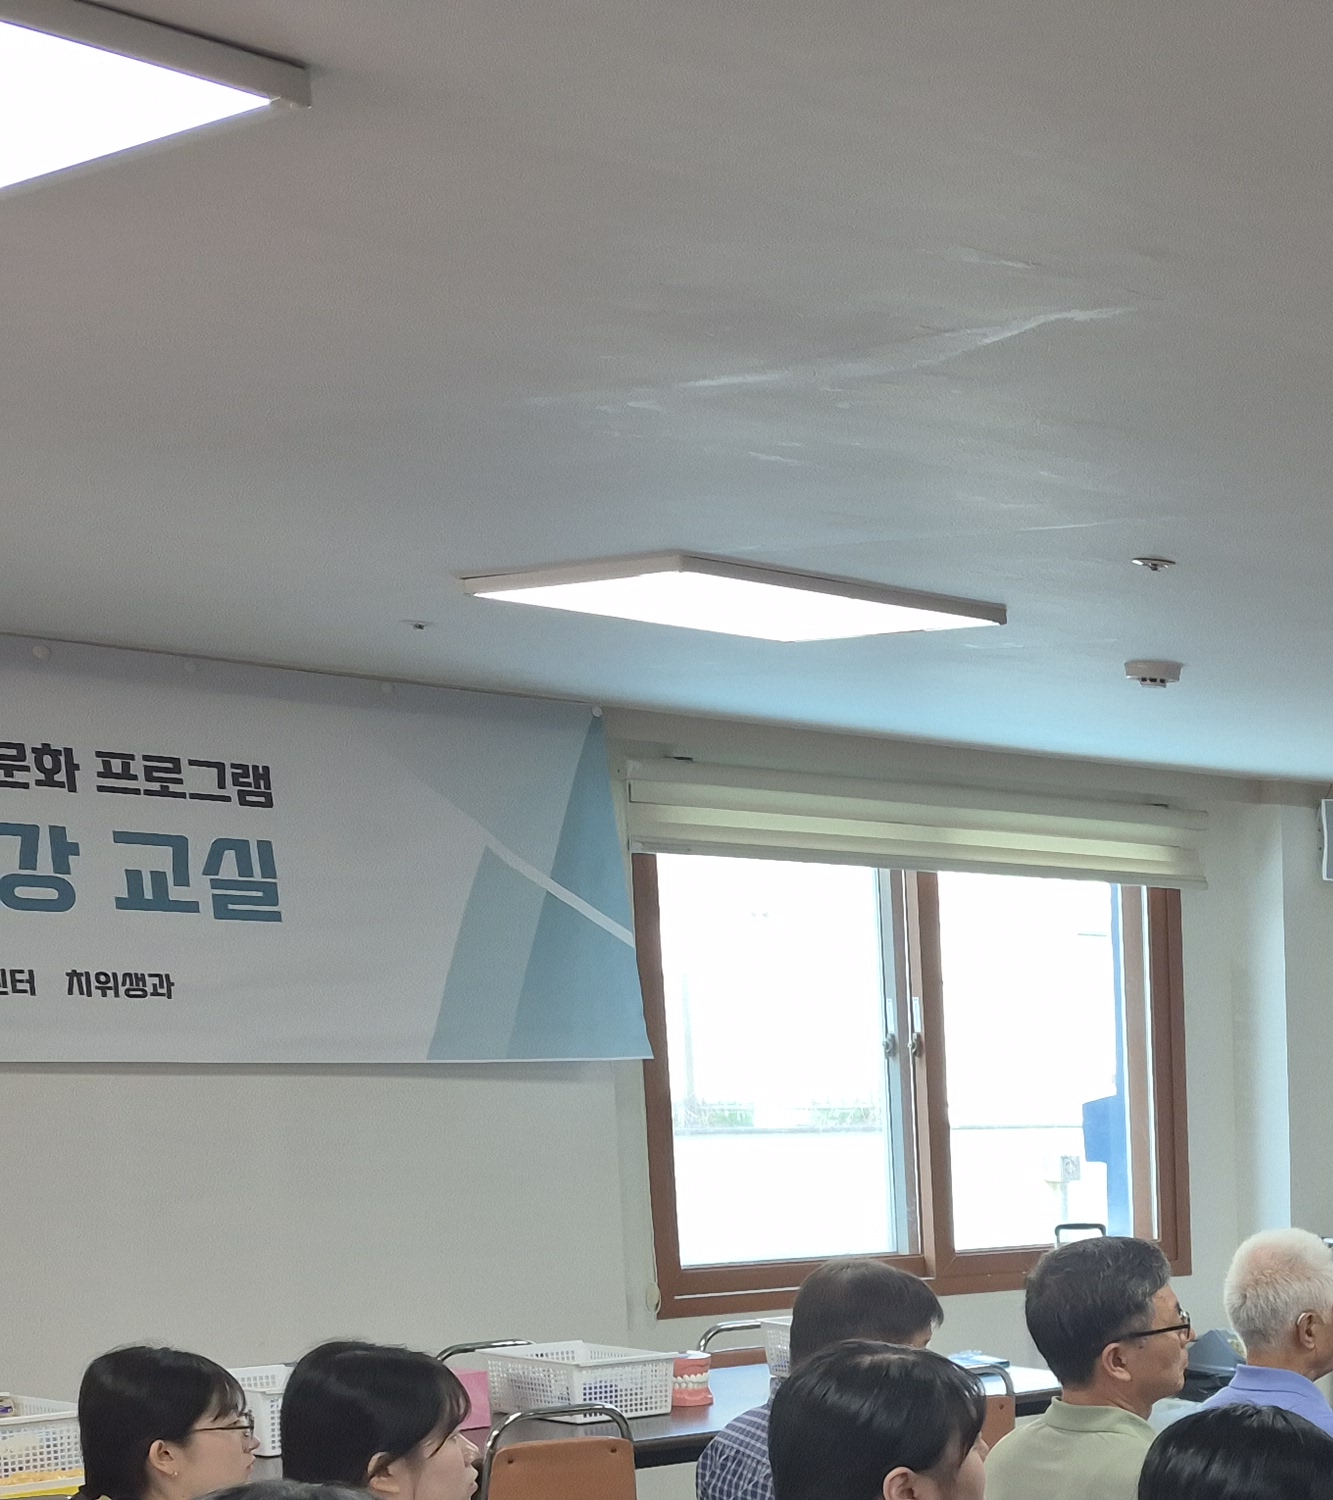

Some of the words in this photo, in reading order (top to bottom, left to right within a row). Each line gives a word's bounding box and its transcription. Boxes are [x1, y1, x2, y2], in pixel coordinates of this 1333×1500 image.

[95, 750, 274, 808] 프로그램
[112, 830, 282, 923] 교실
[65, 969, 175, 999] 치위생과
